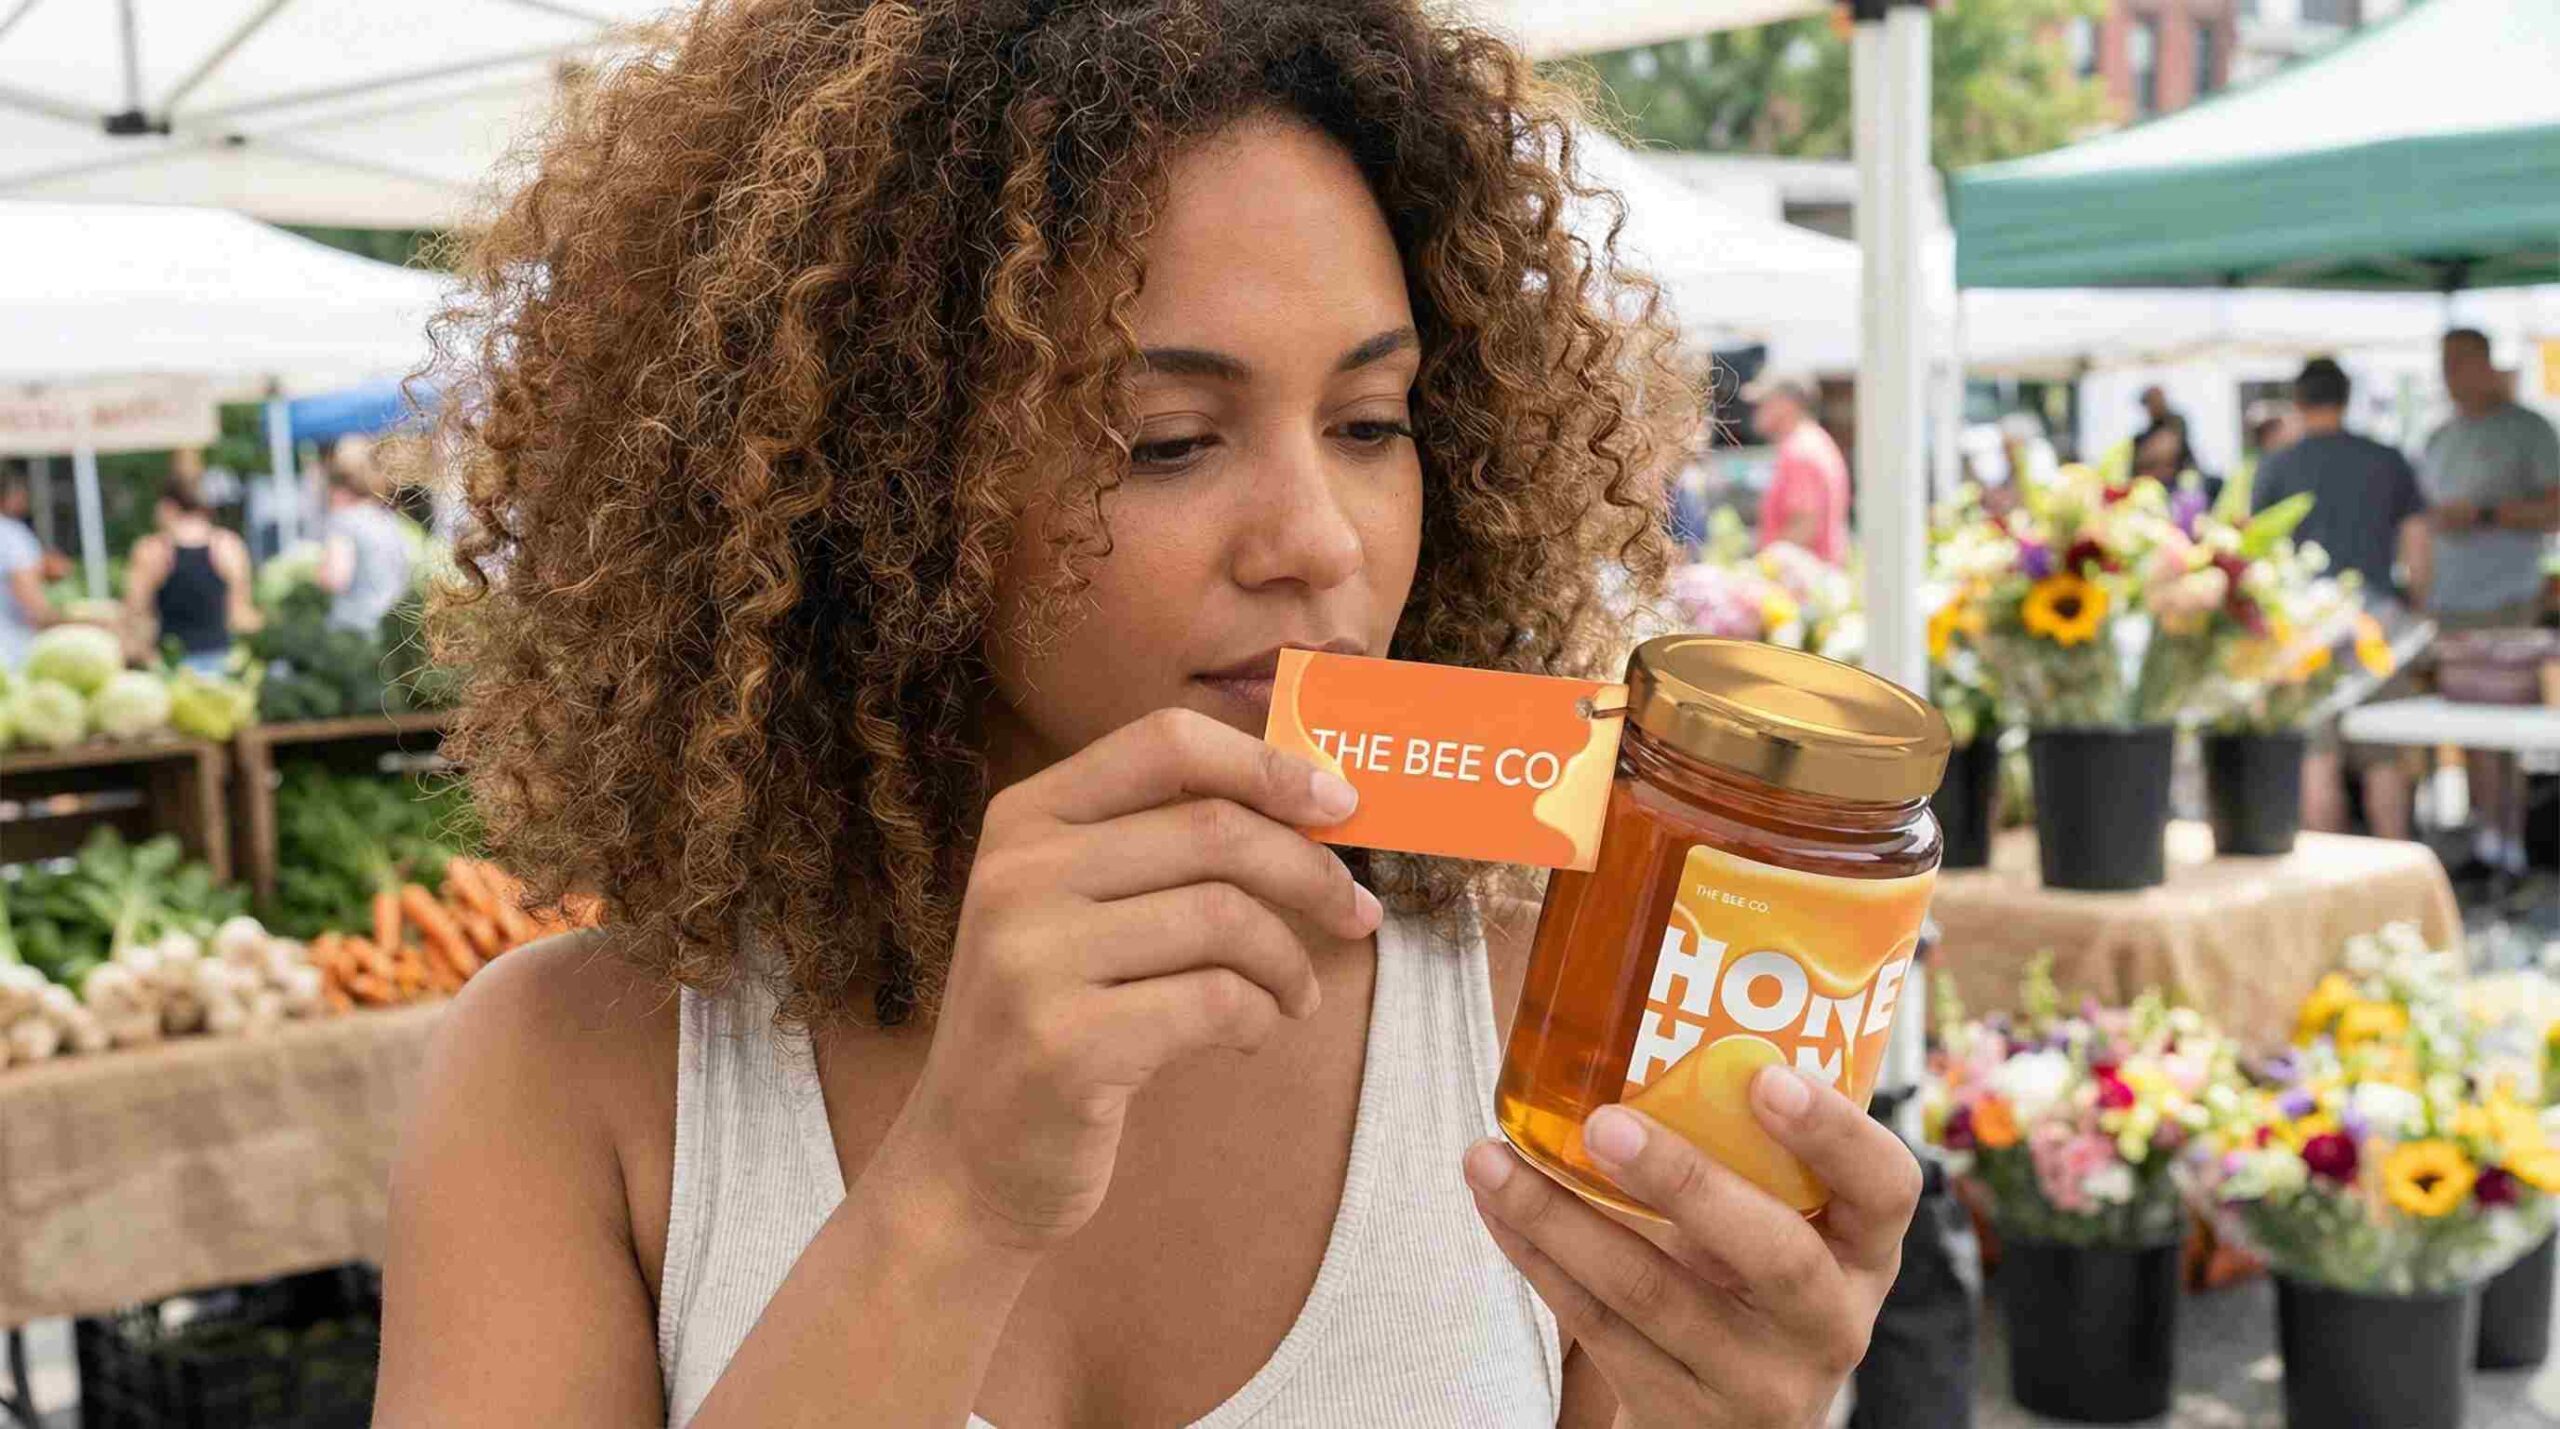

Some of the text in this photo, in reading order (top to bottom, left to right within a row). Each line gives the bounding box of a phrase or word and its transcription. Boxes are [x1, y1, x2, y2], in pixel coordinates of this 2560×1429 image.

[1311, 728, 1560, 790] THE BEE CO
[1696, 884, 1770, 914] THE BEE CO.
